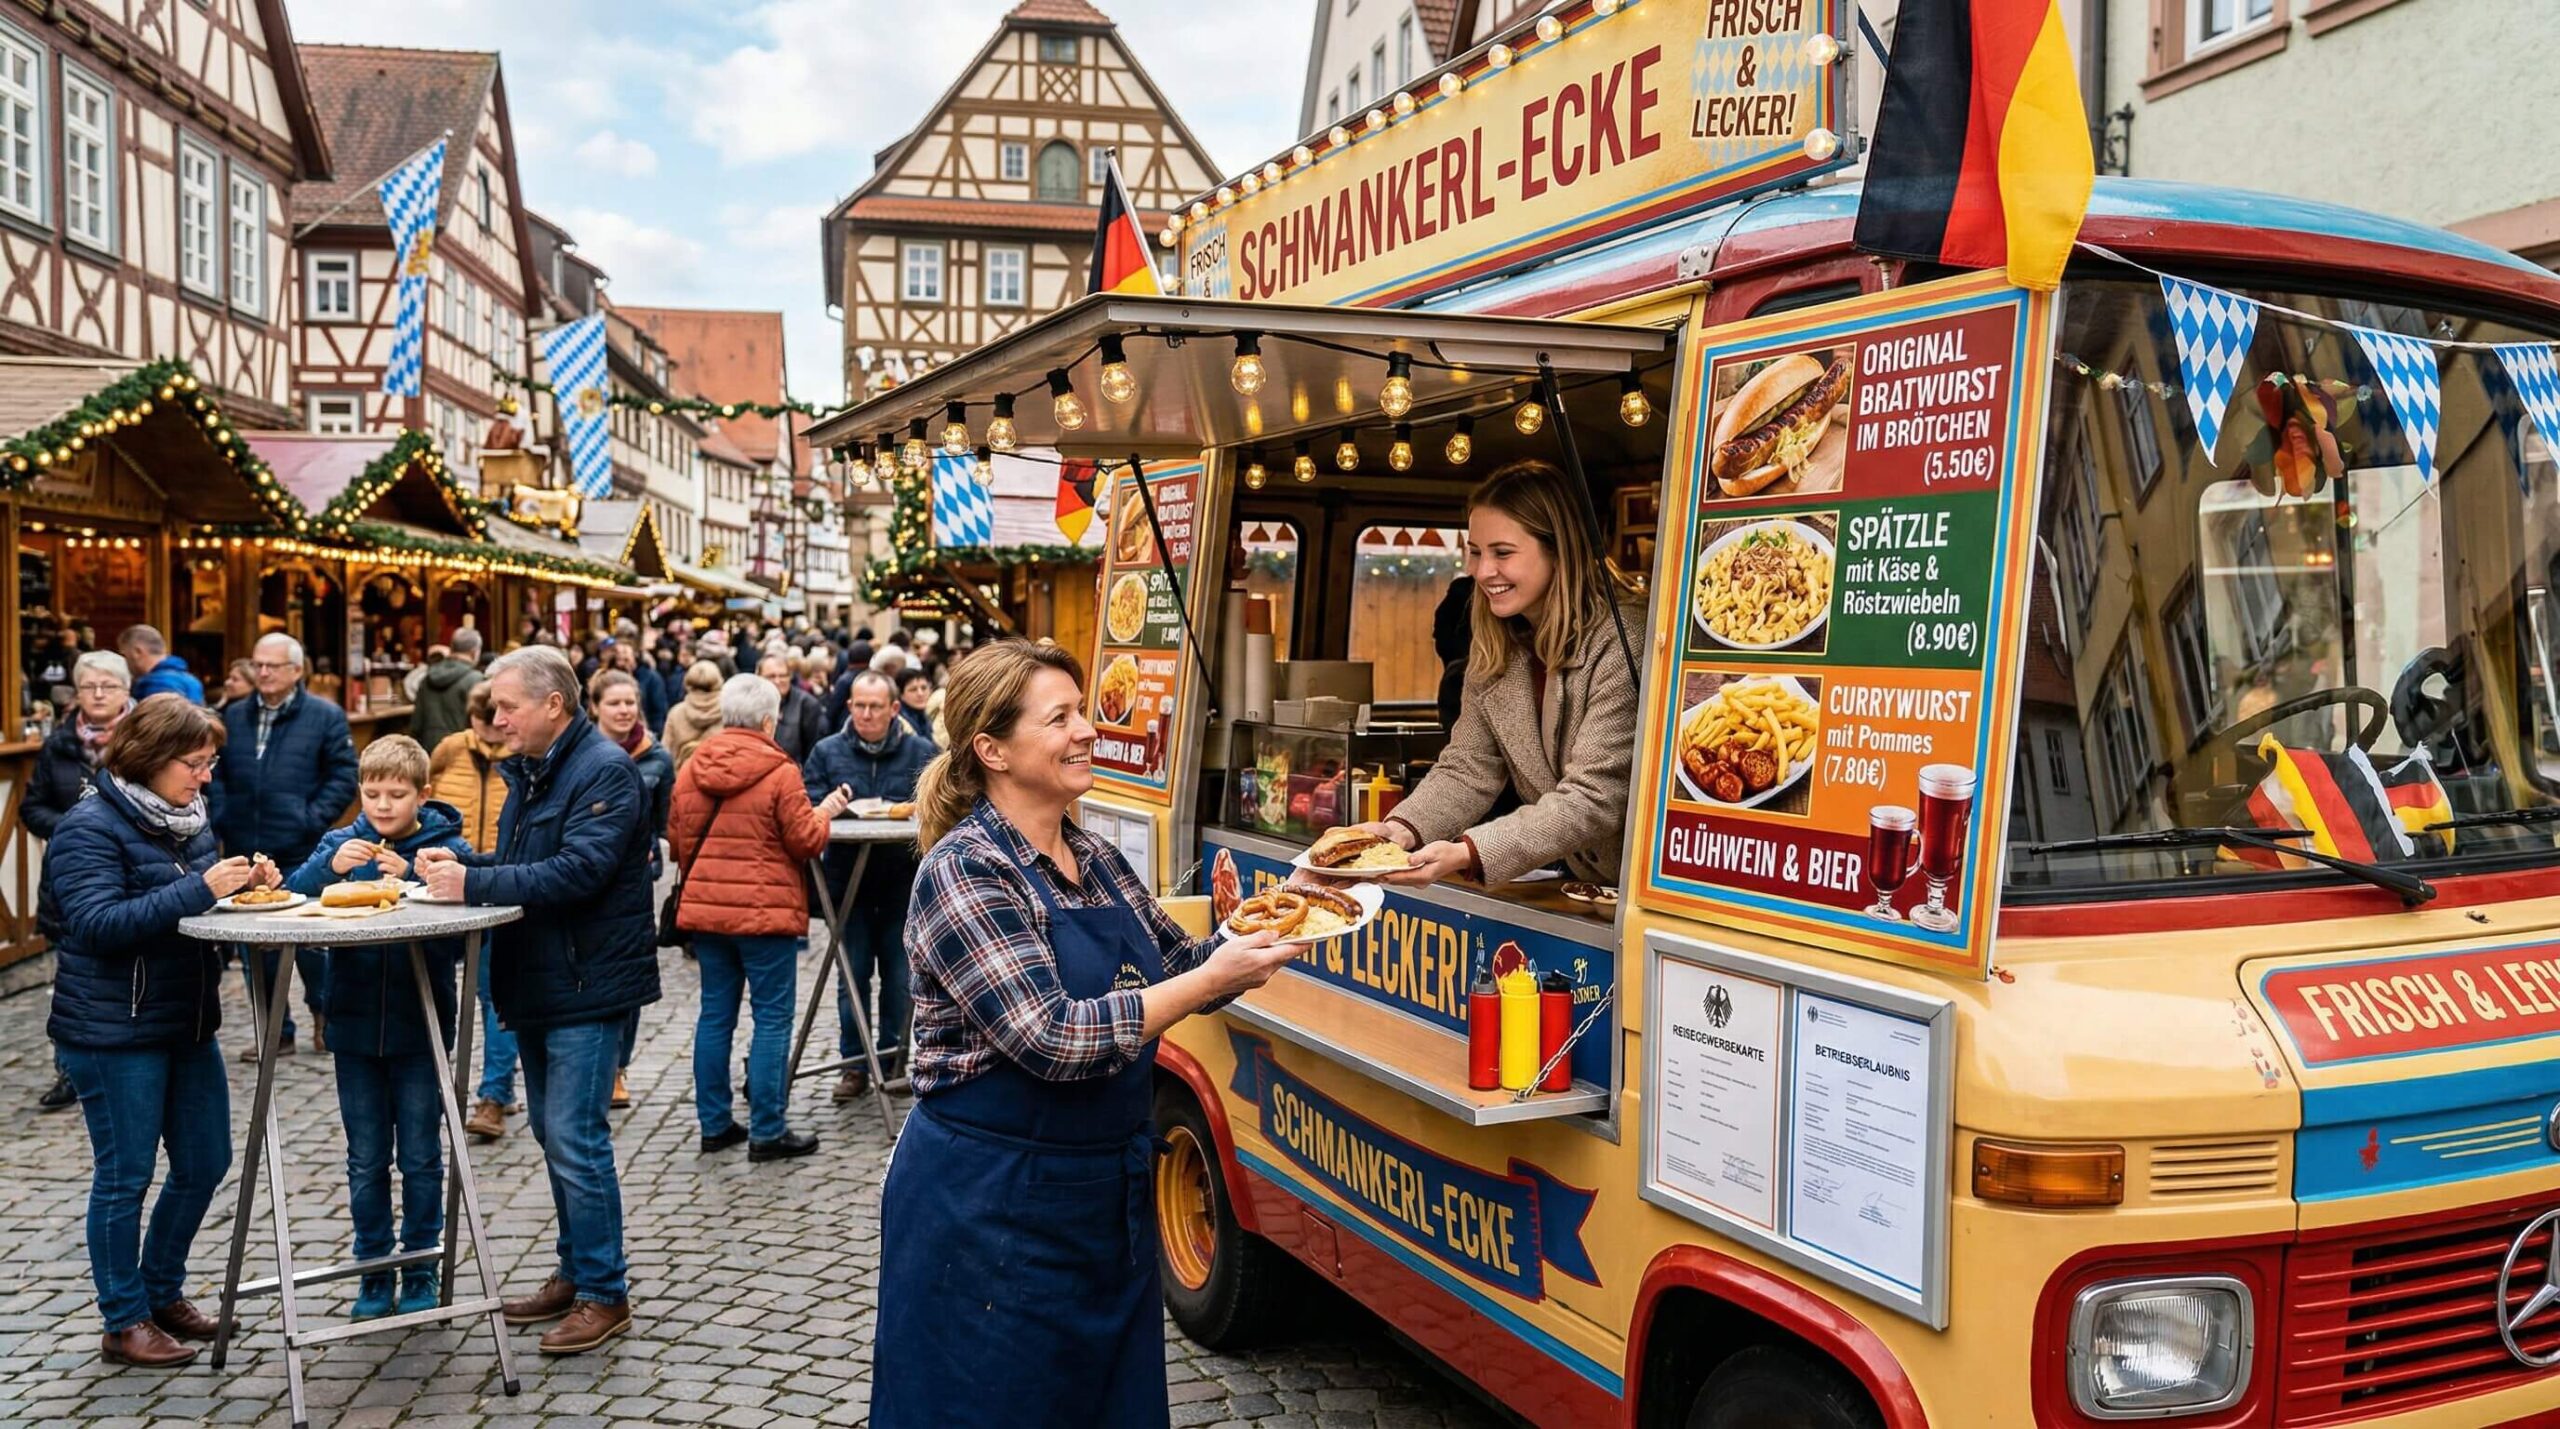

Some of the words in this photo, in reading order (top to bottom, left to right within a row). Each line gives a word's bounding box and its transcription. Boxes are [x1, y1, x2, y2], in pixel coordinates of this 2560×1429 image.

[1706, 0, 1802, 39] FRISCH
[1736, 45, 1757, 88] &
[1691, 93, 1797, 137] LECKER!
[1239, 45, 1662, 300] SCHMANKERL-ECKE
[1190, 232, 1226, 280] FRISCH
[1862, 328, 1968, 376] ORIGINAL
[1859, 364, 2002, 416] BRATWURST
[1856, 422, 1879, 451] IM
[1884, 409, 1991, 448] BRÖTCHEN
[1923, 444, 1995, 486] (5.50€)
[1847, 506, 1951, 551] SPÄTZLE
[1845, 557, 1875, 582] mit
[1878, 556, 1921, 582] Käse
[1925, 554, 1939, 581] &
[1843, 587, 1961, 615] Röstzwiebeln
[1907, 620, 1978, 657] (8.90€)
[1830, 685, 1972, 723] CURRYWURST
[1826, 723, 1854, 748] mit
[1858, 725, 1933, 755] Pommes
[1823, 754, 1887, 792] (7.80€)
[1668, 823, 1778, 879] GLÜHWEIN
[1782, 843, 1800, 882] &
[1807, 847, 1862, 893] BIER
[1352, 906, 1469, 1021] LECKER!
[2298, 972, 2468, 1042] FRISCH
[2452, 969, 2508, 1021] &
[1272, 1083, 1520, 1278] SCHMANKERL-ECKE
